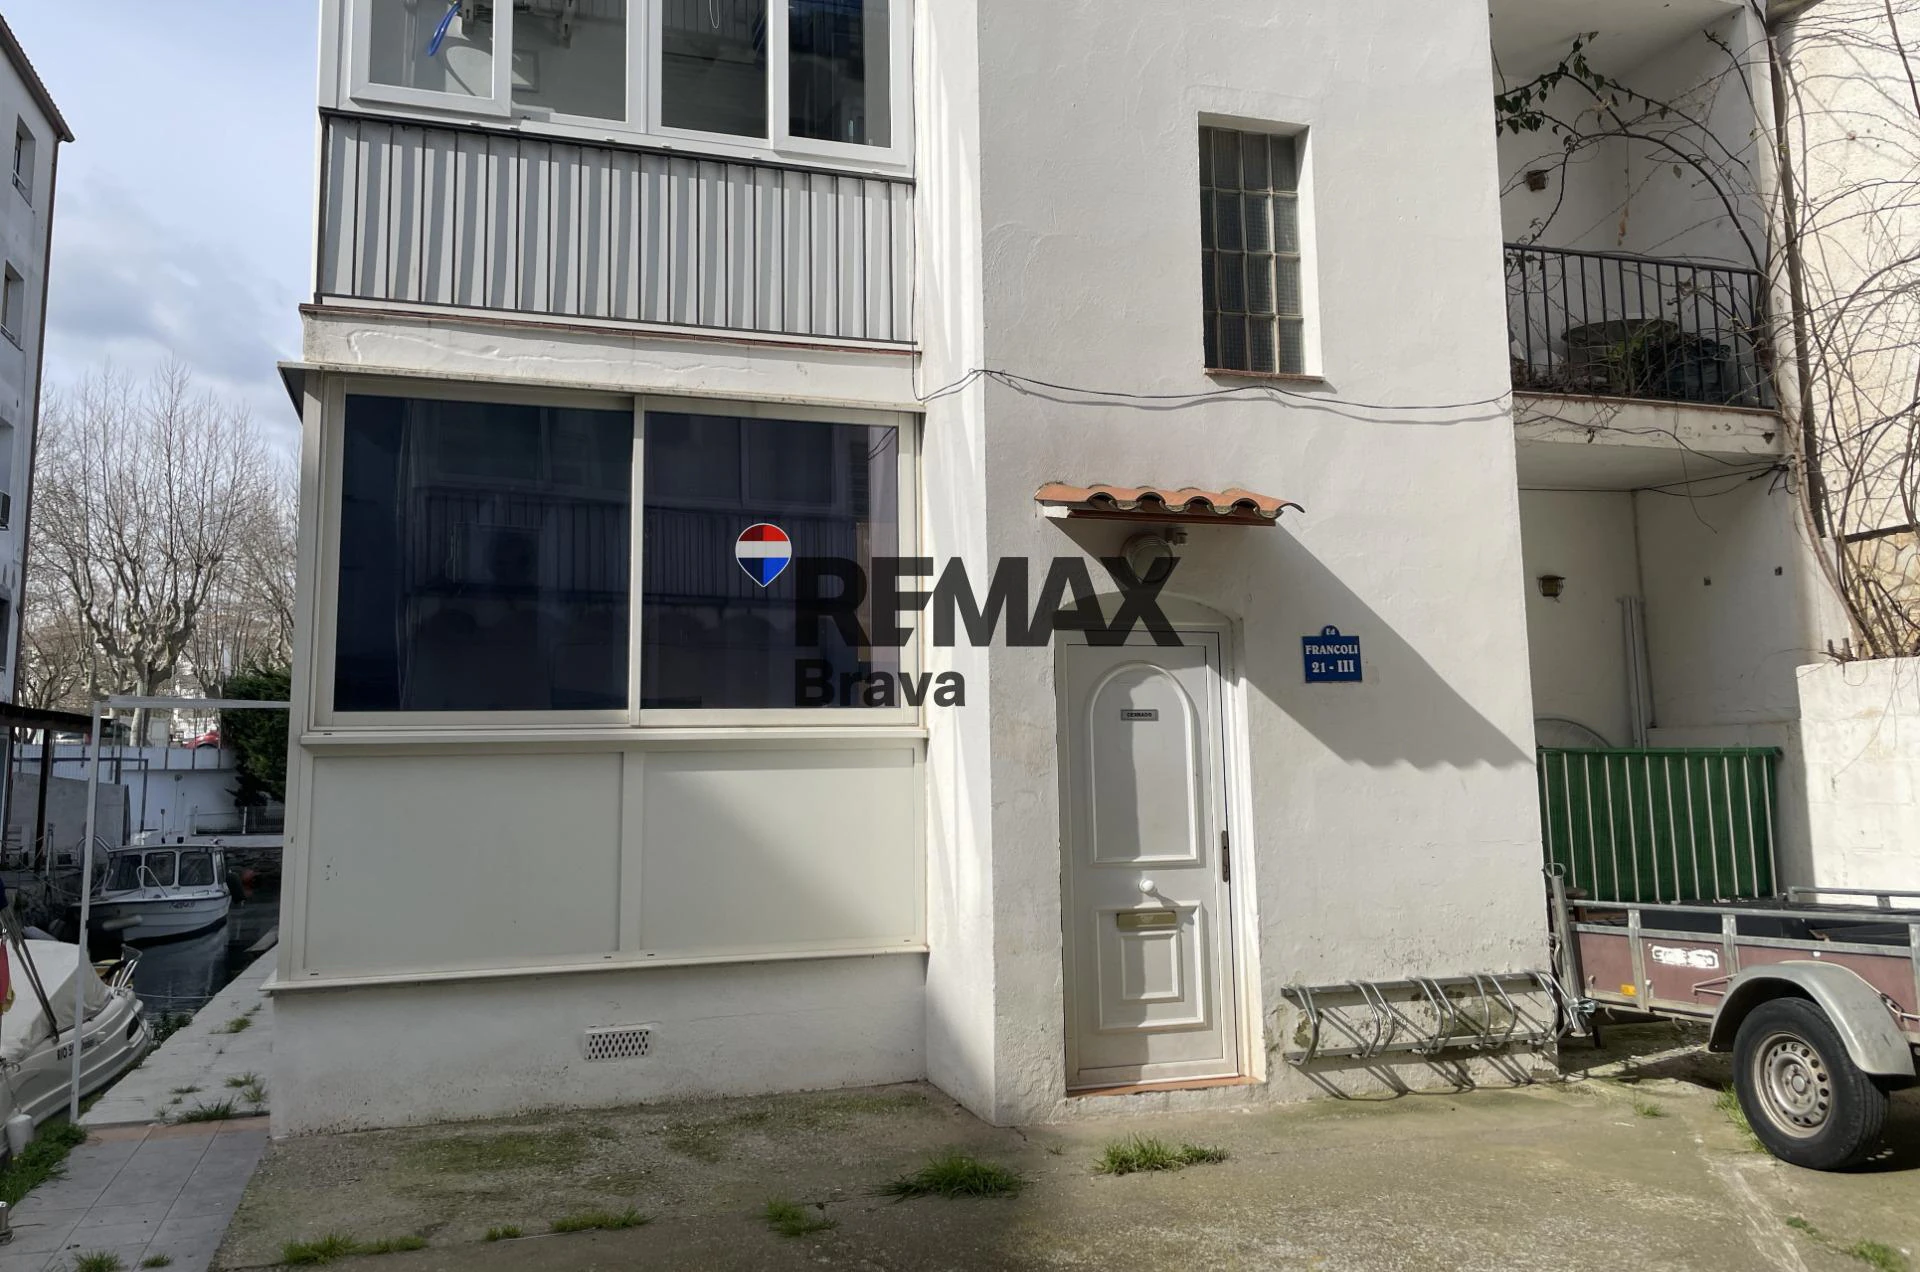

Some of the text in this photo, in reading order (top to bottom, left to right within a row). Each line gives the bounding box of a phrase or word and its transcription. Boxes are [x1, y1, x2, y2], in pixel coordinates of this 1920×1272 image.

[1305, 645, 1359, 655] FRANCOLI
[1312, 662, 1326, 673] 21
[1337, 660, 1355, 673] III
